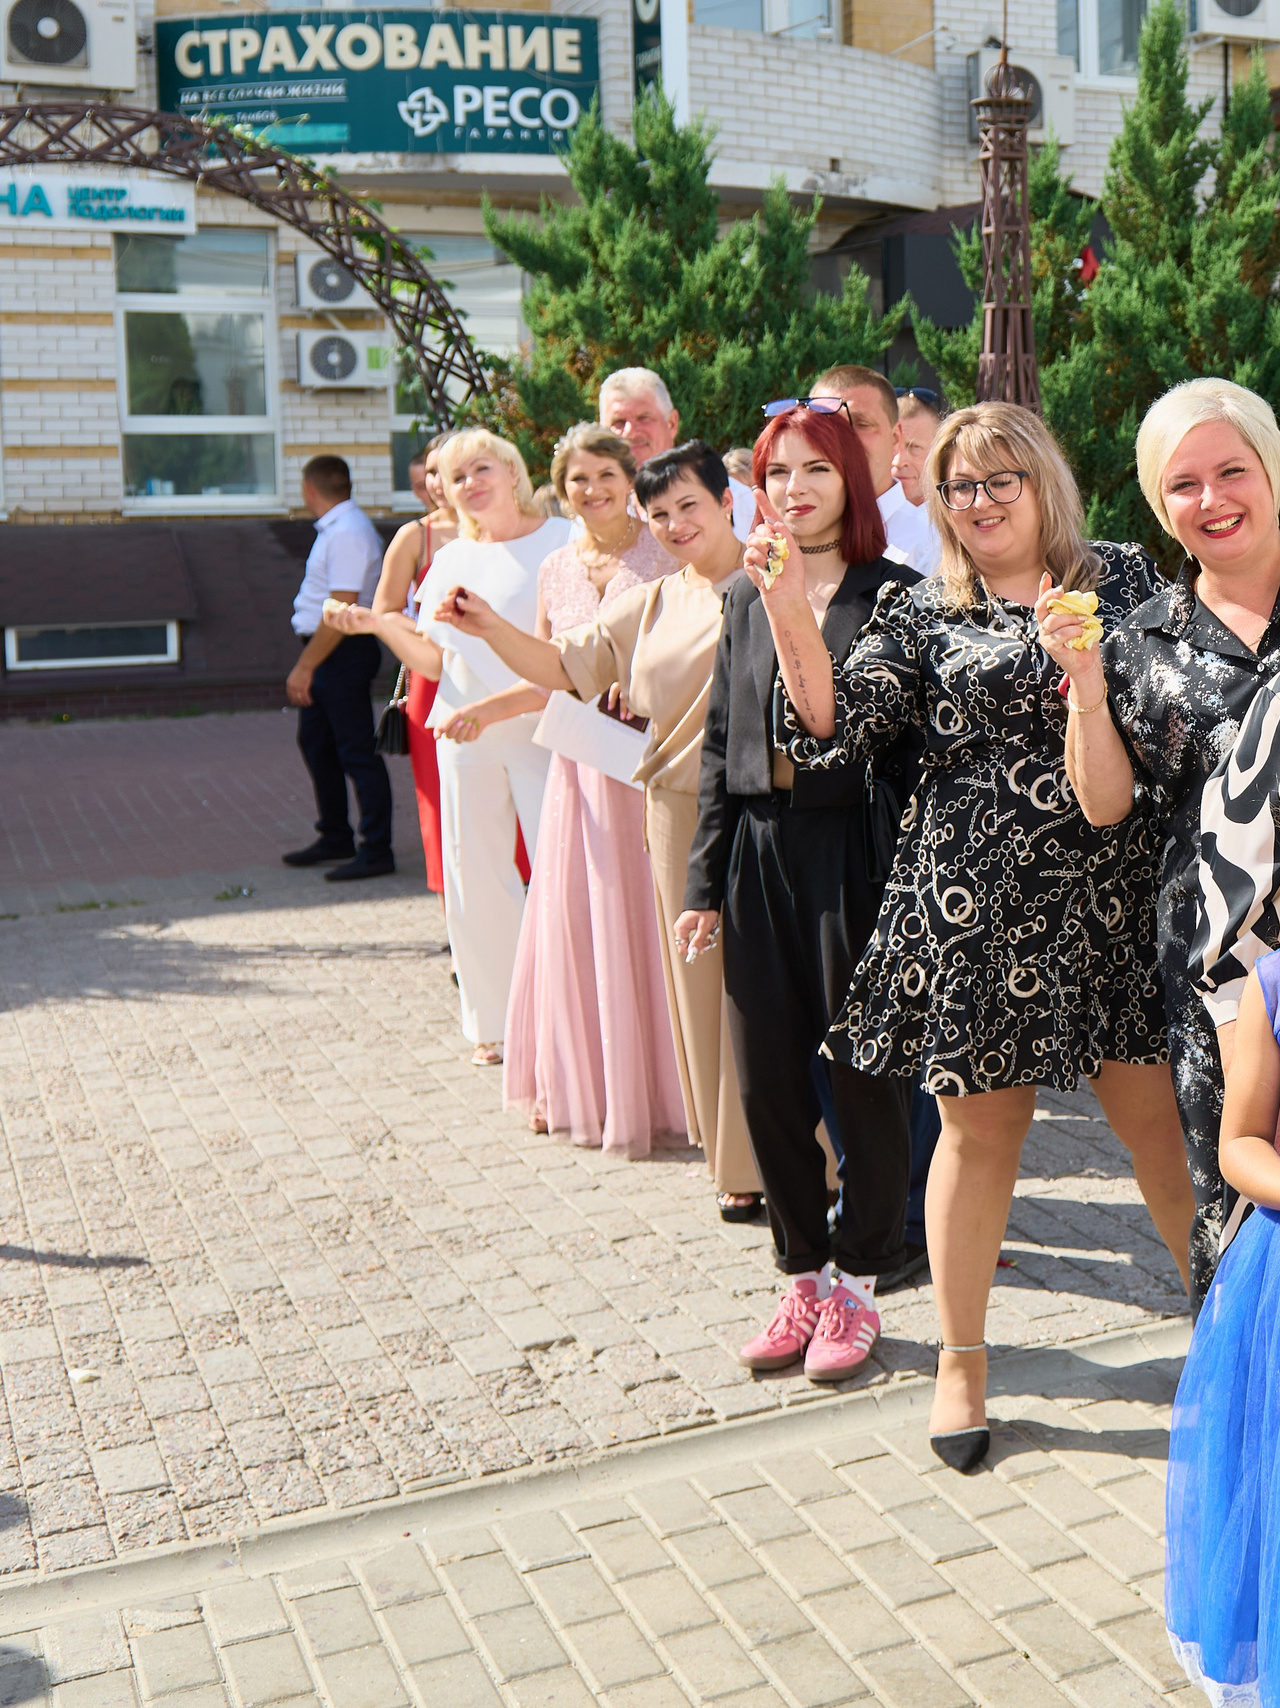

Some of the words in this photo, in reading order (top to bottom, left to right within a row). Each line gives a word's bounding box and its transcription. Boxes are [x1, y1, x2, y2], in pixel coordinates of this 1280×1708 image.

[174, 22, 582, 79] СТРАХОВАНИЕ
[180, 90, 200, 105] НА
[453, 85, 580, 129] РЕСО
[67, 186, 127, 202] ЦЕНТР
[67, 203, 185, 222] ПОДОЛОГИИ
